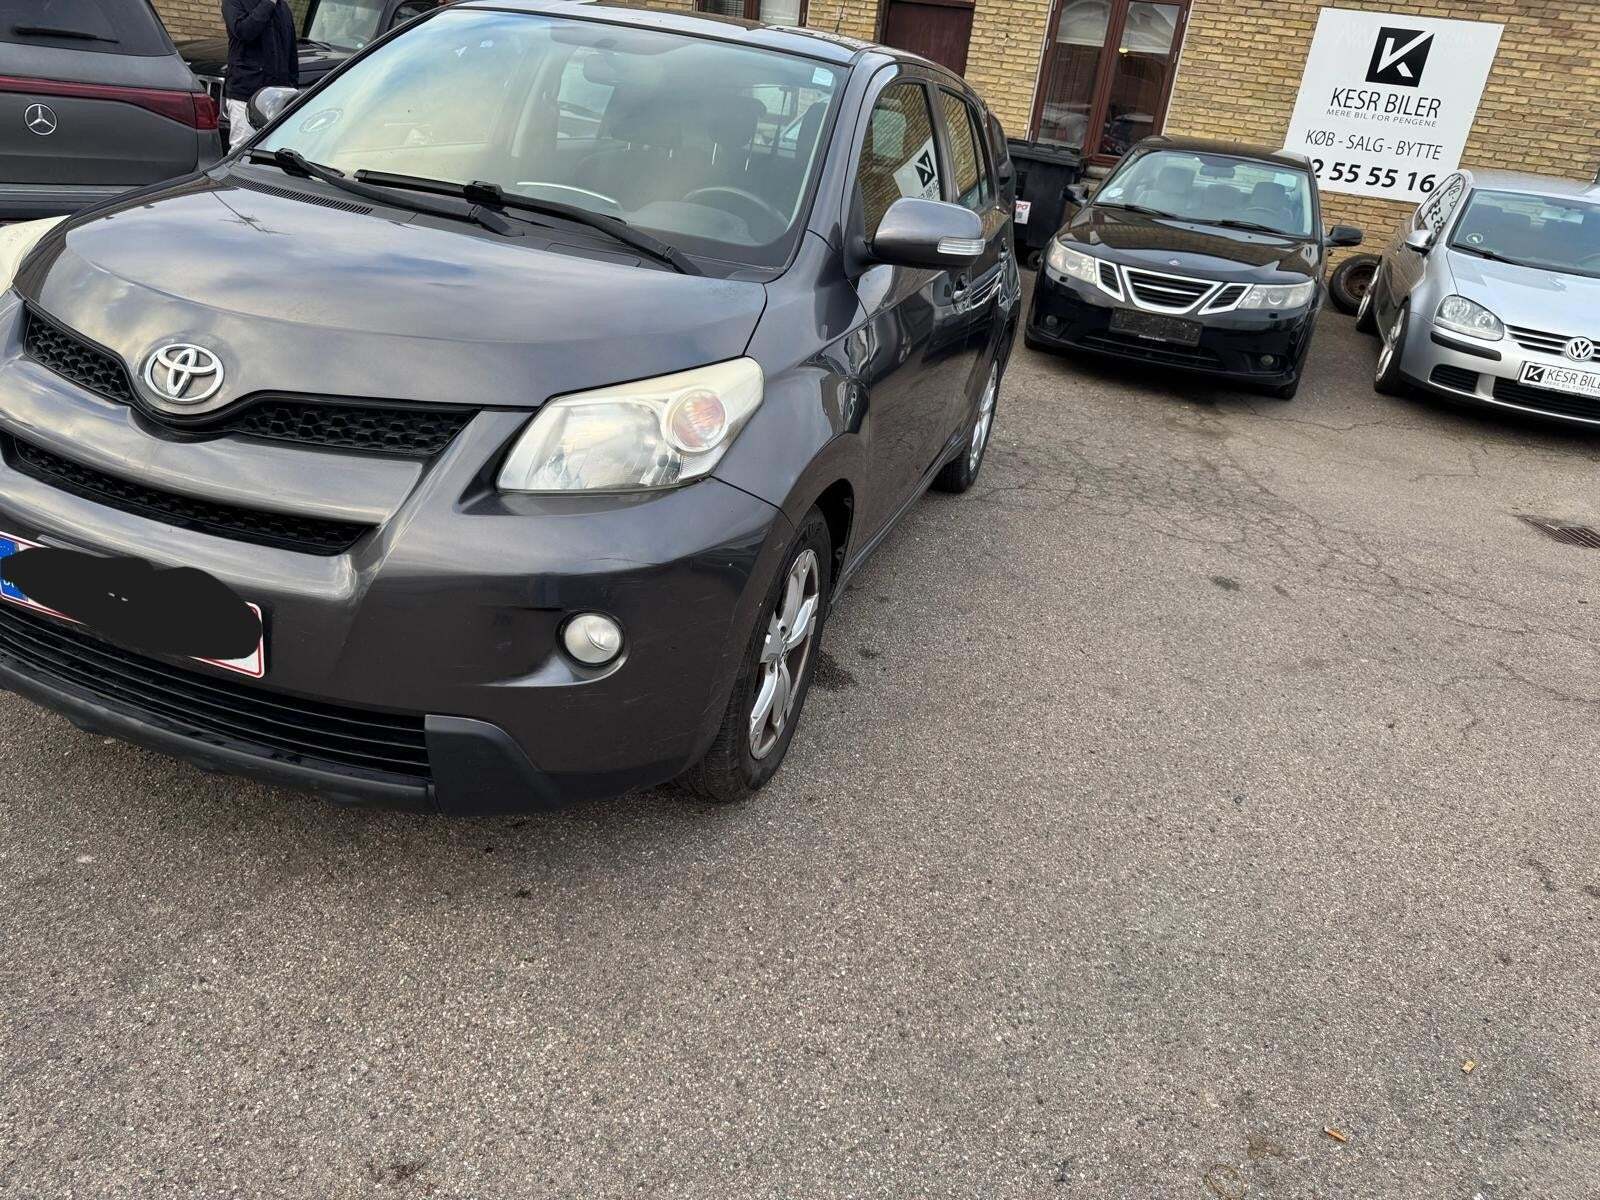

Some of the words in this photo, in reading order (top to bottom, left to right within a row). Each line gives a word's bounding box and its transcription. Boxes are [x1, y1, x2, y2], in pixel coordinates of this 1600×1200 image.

[1326, 108, 1351, 117] MERE
[1354, 112, 1369, 120] BIL
[1371, 114, 1390, 122] FOR
[1392, 116, 1438, 128] PENGENE
[1330, 87, 1381, 111] KESR
[1384, 93, 1442, 119] BILER
[1305, 129, 1336, 147] KØB
[1345, 134, 1385, 153] SALG
[1395, 140, 1443, 160] BYTTE
[1328, 161, 1361, 183] 55
[1365, 166, 1398, 188] 55
[1407, 171, 1436, 193] 16
[1546, 369, 1578, 385] KESR
